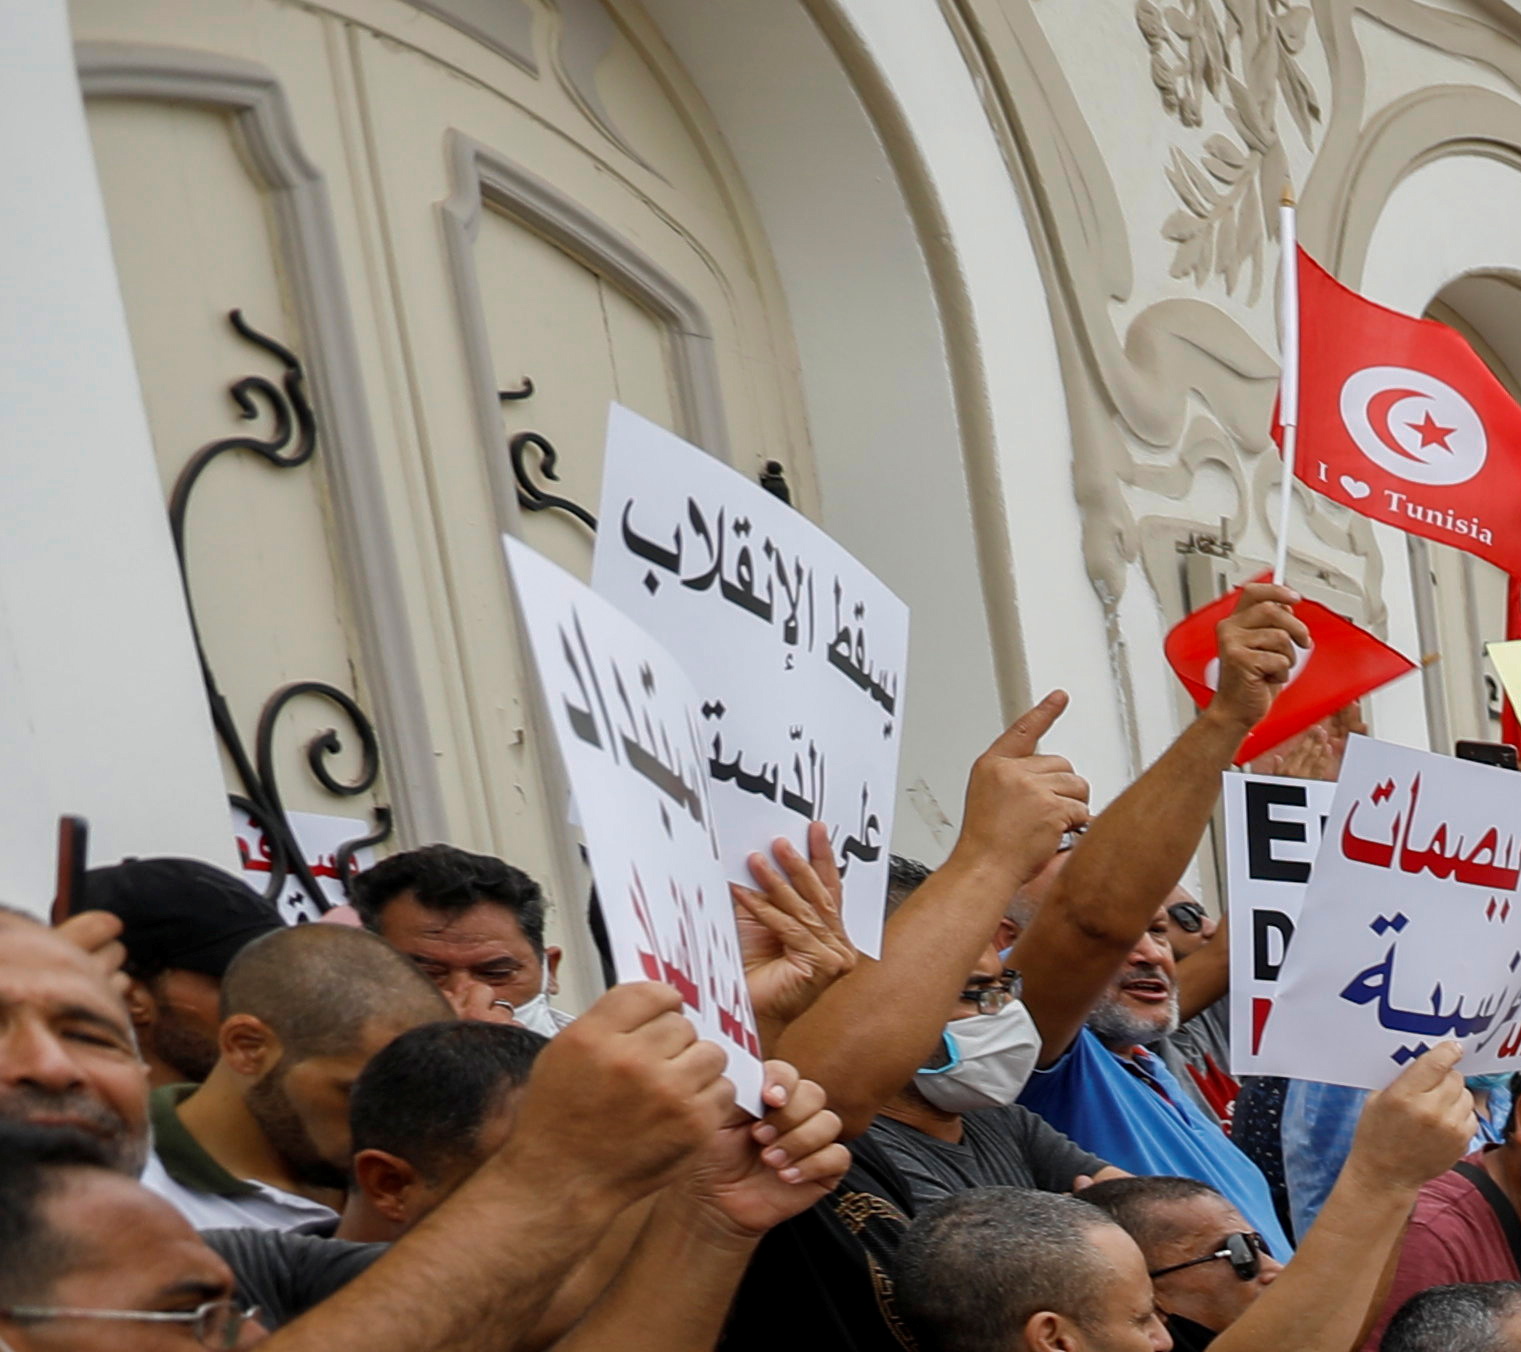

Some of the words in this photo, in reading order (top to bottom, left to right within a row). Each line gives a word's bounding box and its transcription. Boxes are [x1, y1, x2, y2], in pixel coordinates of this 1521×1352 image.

[620, 496, 815, 672] الإنقلاب
[1384, 489, 1494, 547] Tunisia
[826, 574, 898, 740] يسقط
